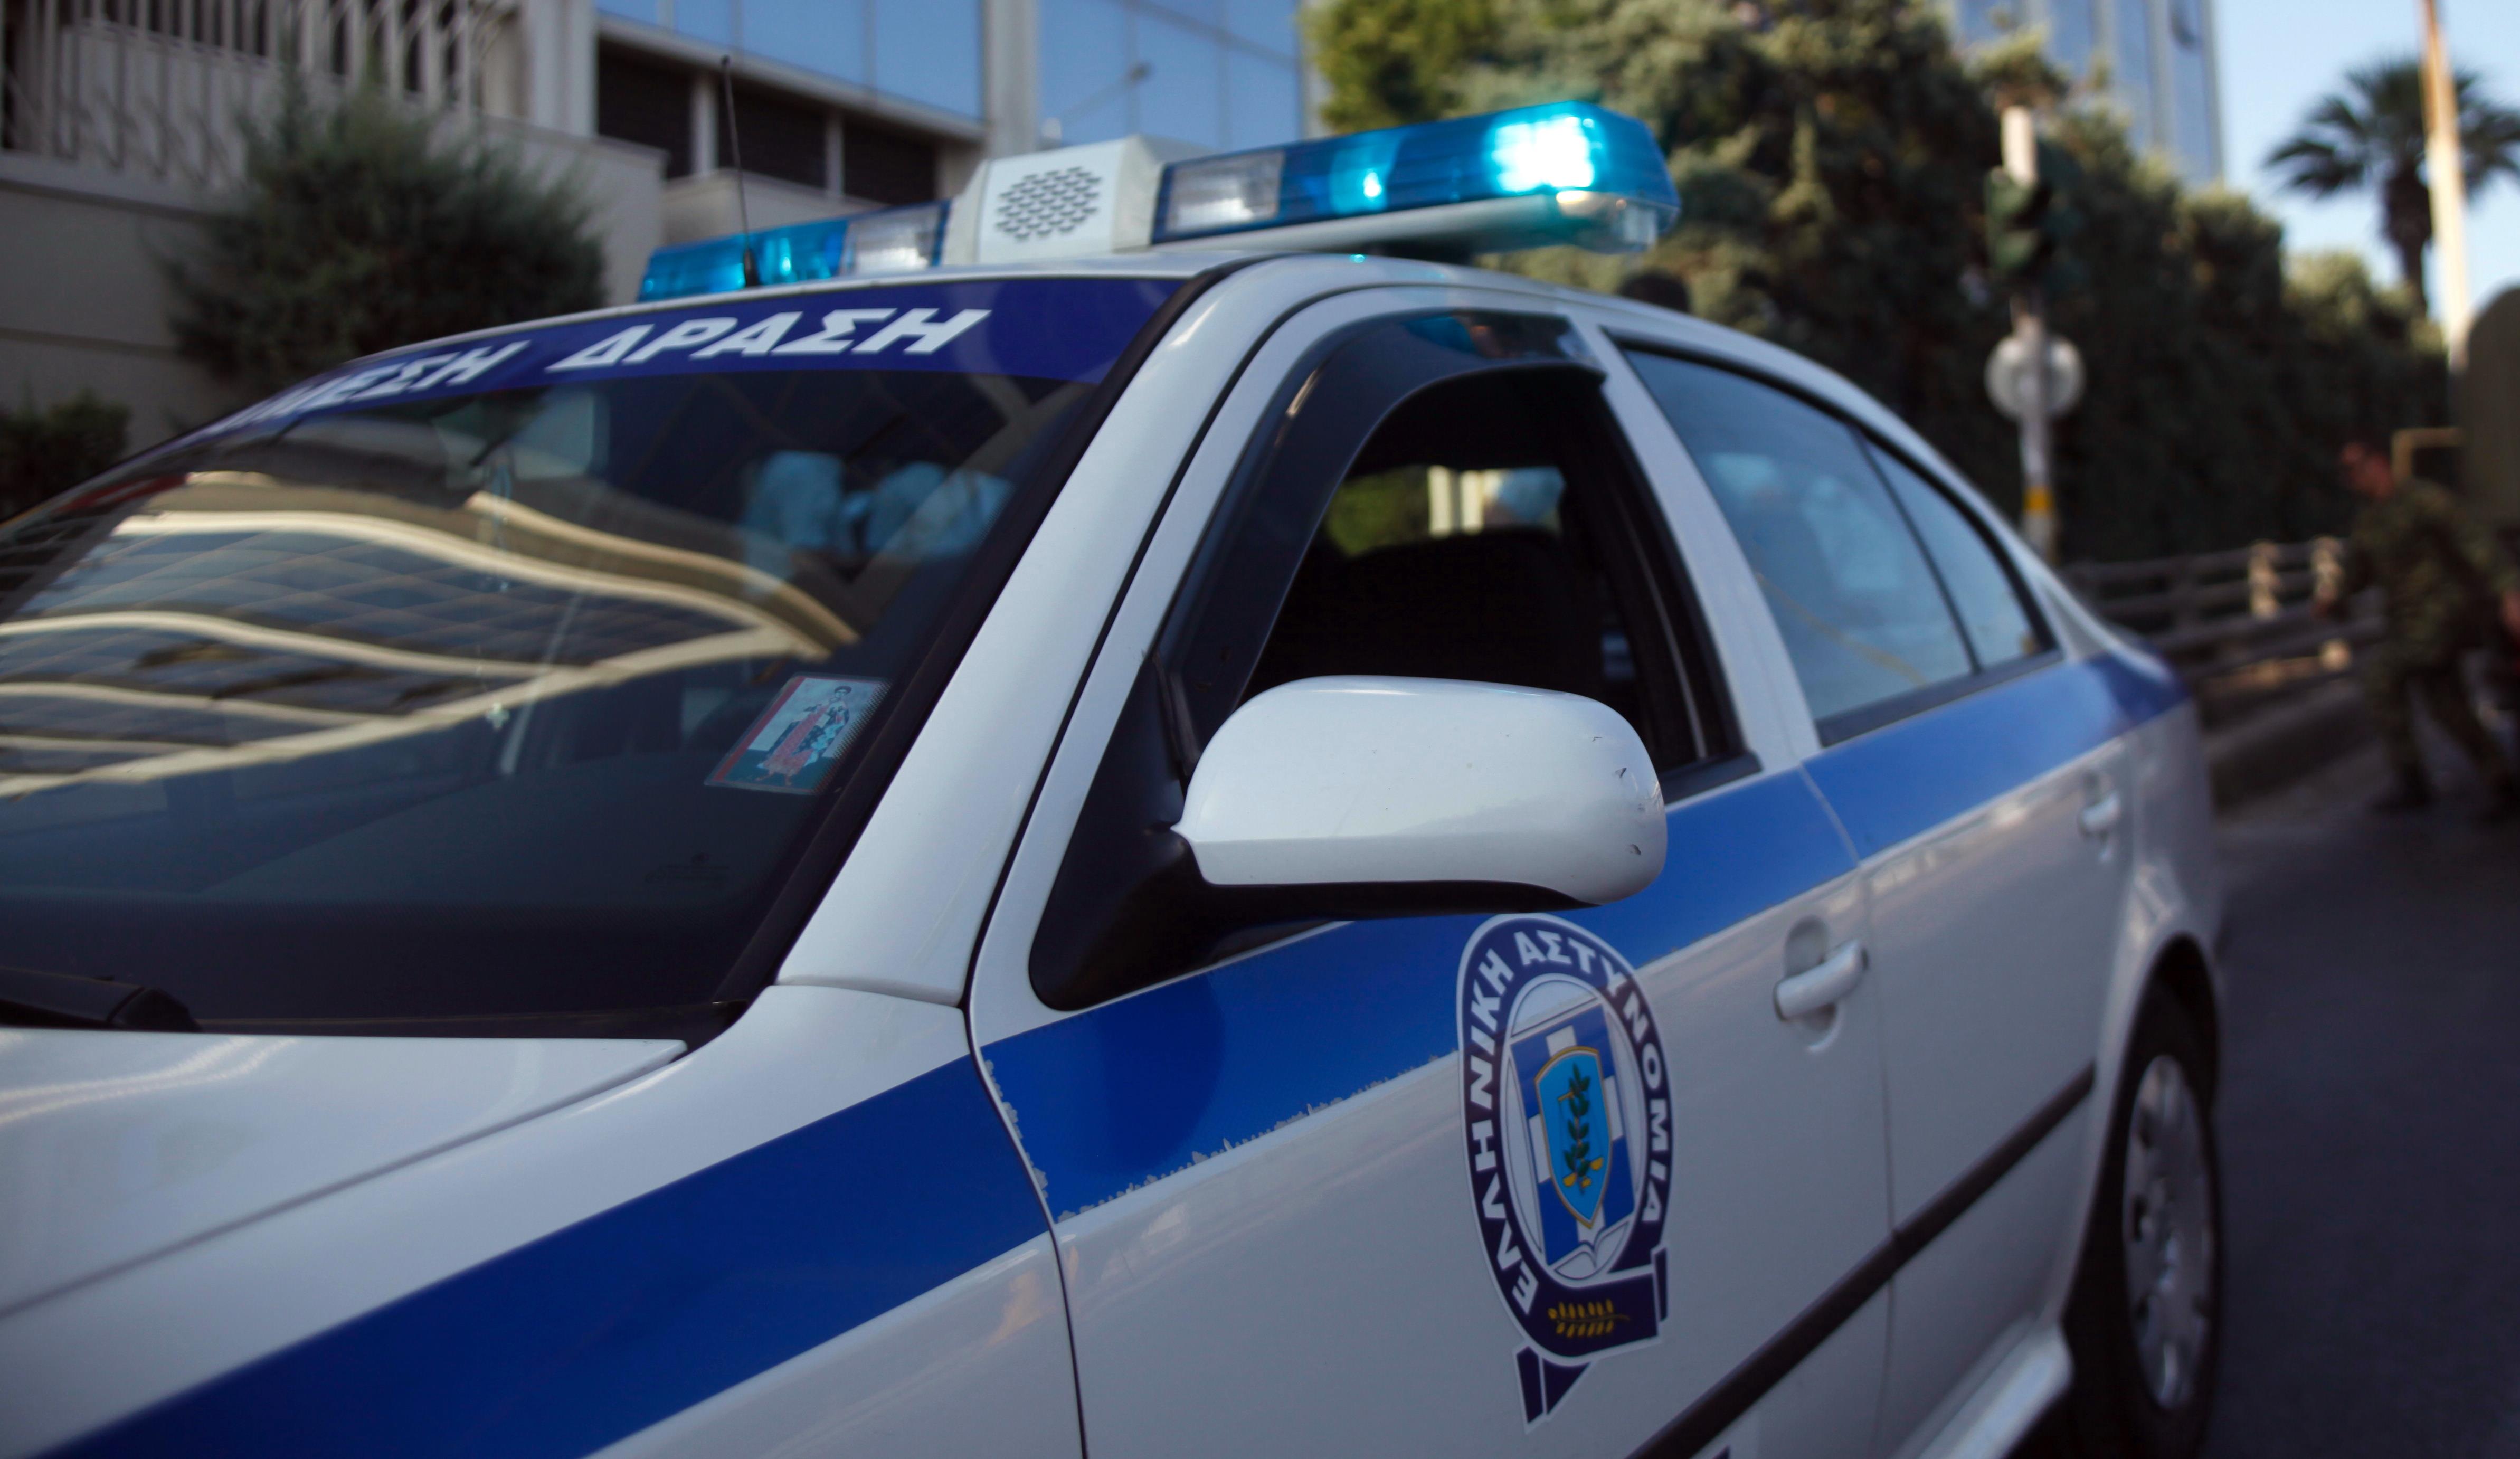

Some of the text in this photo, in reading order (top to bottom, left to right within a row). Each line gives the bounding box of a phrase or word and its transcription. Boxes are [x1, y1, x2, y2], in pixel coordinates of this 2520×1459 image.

[545, 308, 992, 373] ΔΡΑΣΗ
[1470, 930, 1669, 1315] ΕΛΛΗΝΙΚΗ ΑΣΤΥΝΟΜΙΑ
